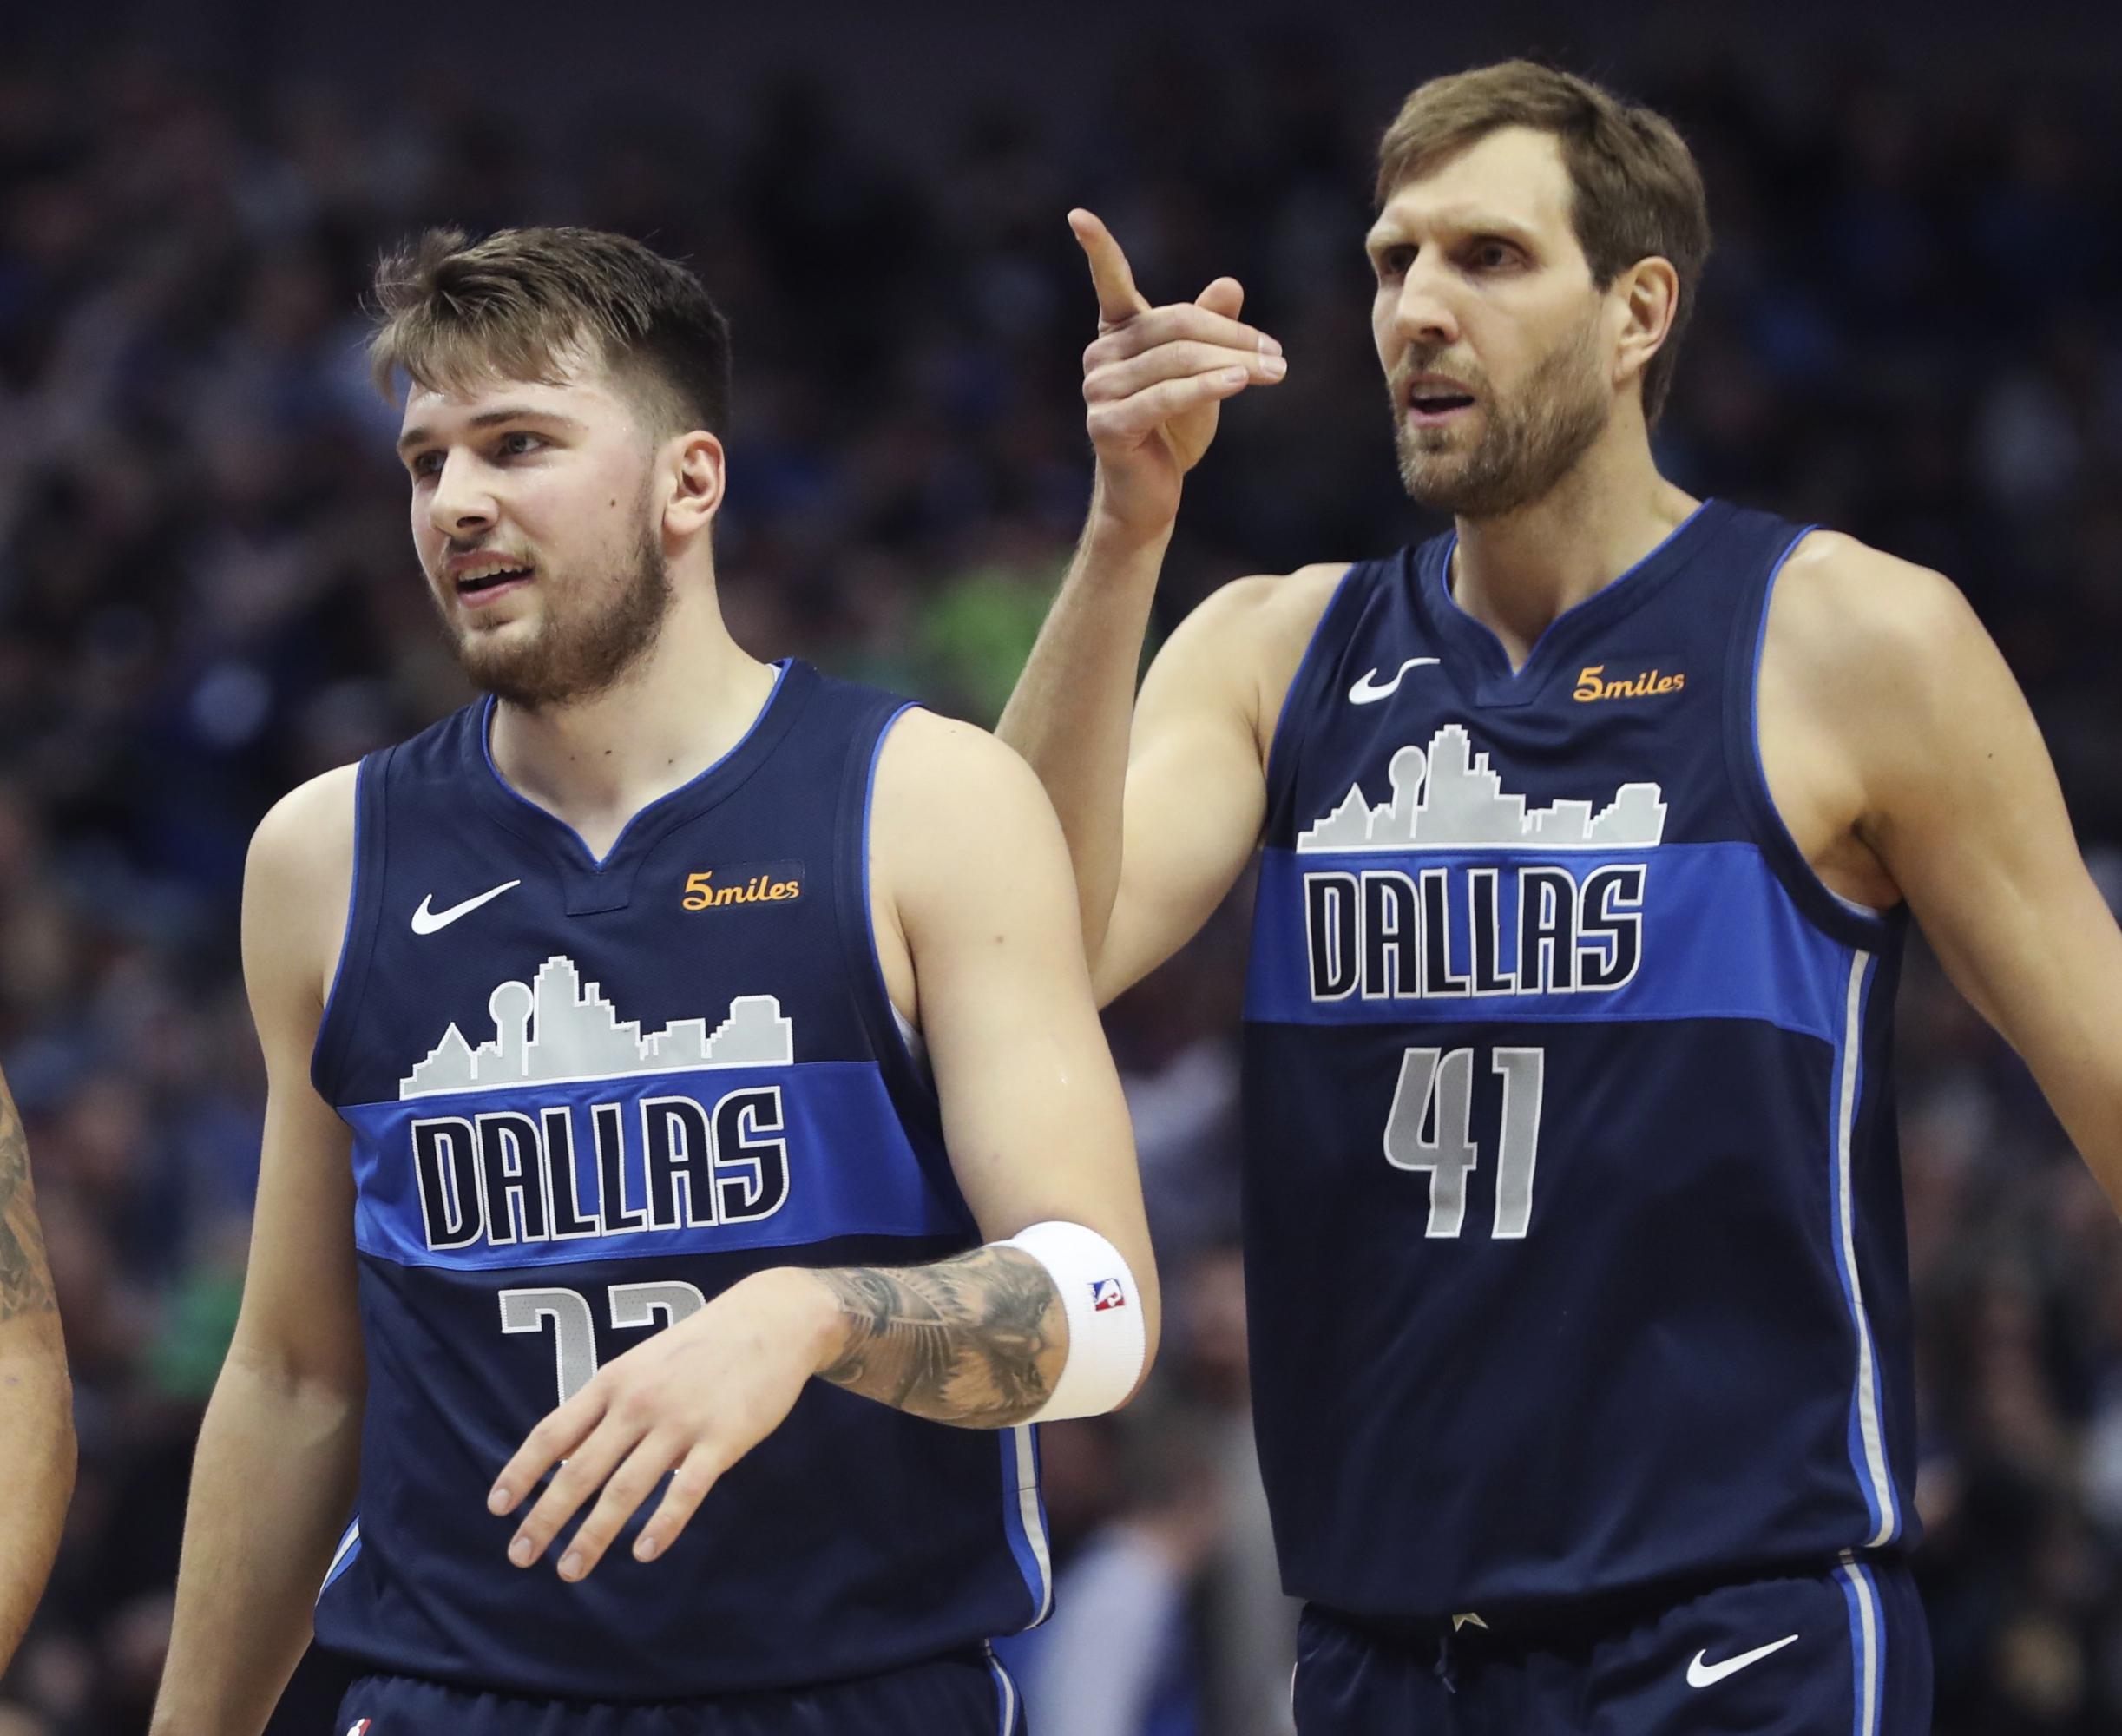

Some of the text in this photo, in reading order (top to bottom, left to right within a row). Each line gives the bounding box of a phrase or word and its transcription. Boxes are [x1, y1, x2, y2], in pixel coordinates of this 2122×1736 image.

[1573, 664, 1685, 702] 5miles
[682, 870, 800, 911] 5miles
[1304, 864, 1647, 1002] DALLAS
[411, 1086, 790, 1250] DALLAS
[1383, 1047, 1544, 1238] 41
